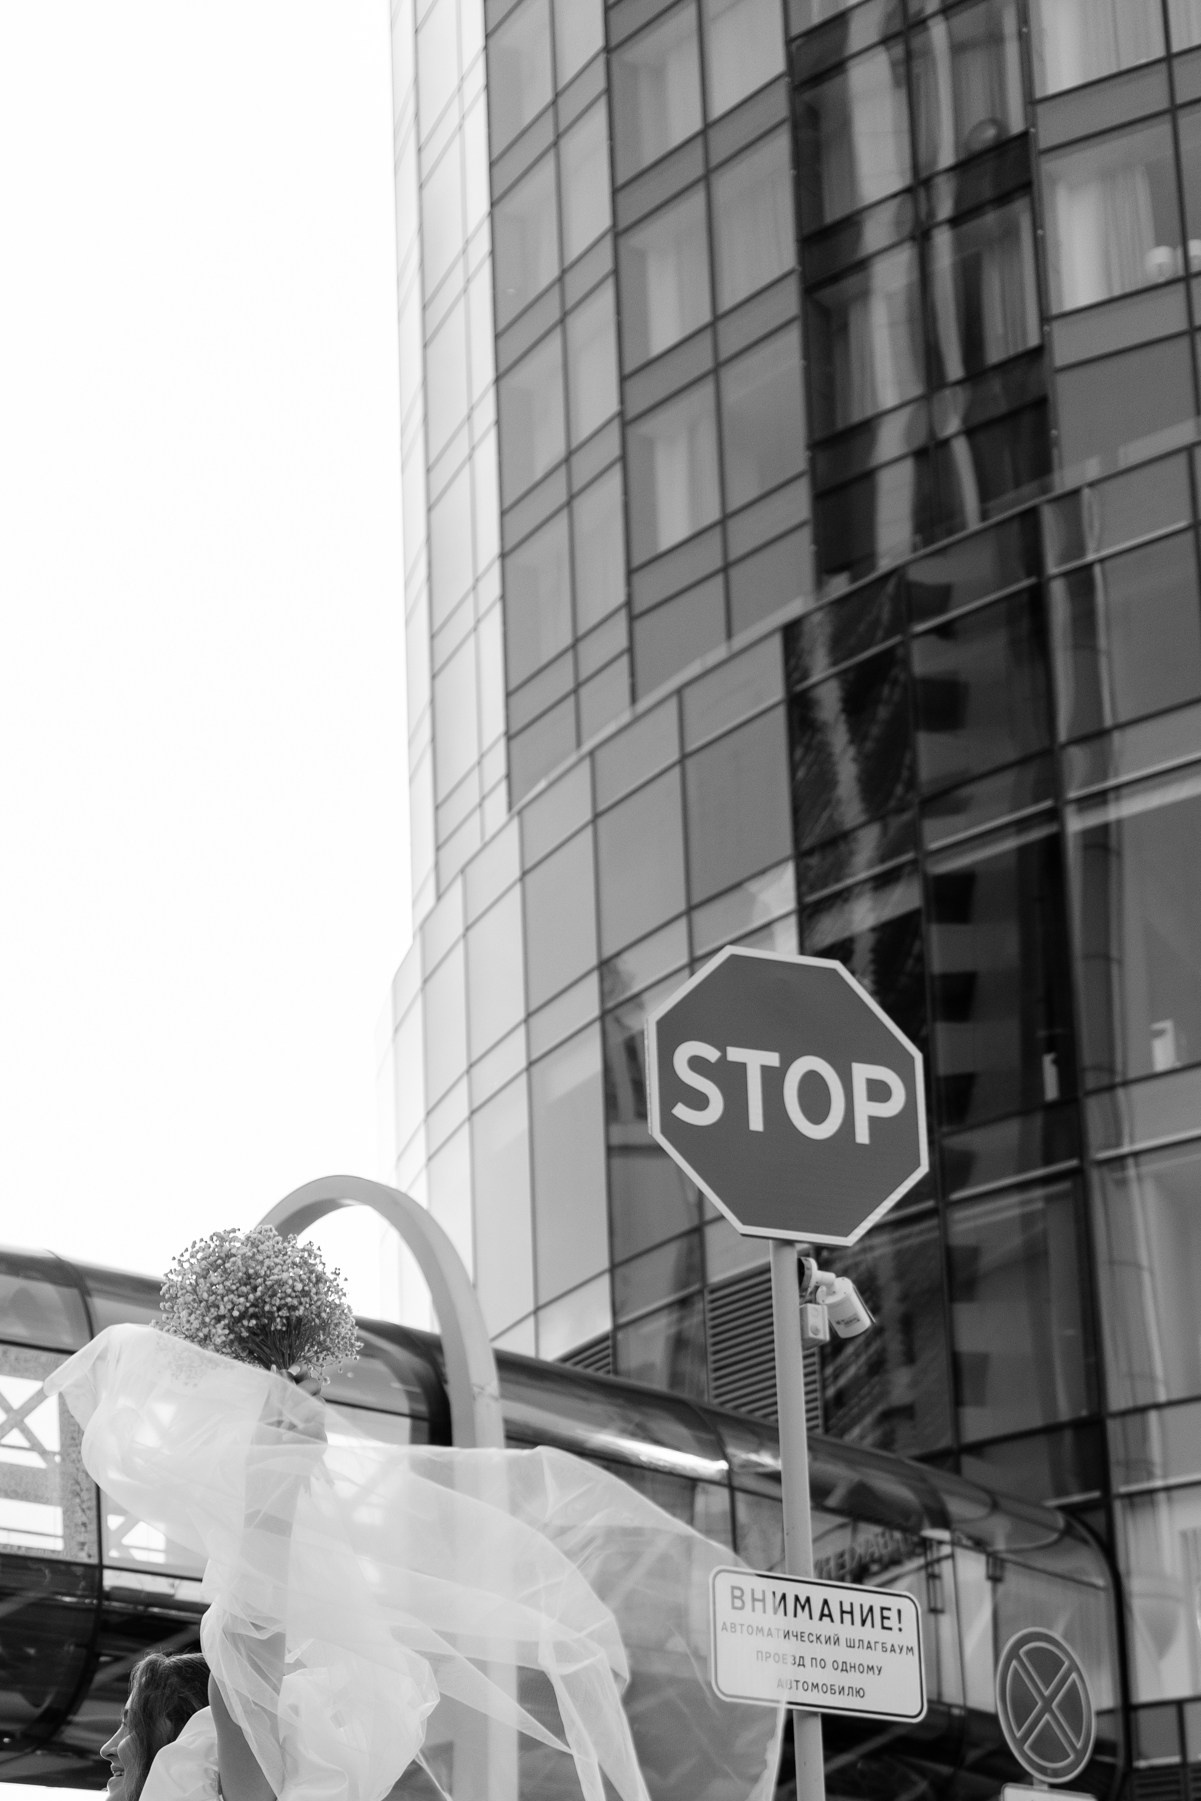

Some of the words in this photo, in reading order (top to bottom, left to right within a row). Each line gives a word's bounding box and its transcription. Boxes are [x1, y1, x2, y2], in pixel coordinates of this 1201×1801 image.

[671, 1040, 906, 1145] STOP
[730, 1585, 903, 1632] ВНИМАНИЕ!
[721, 1621, 840, 1646] АВТОМАТИЧЕСКИЙ
[845, 1638, 914, 1656] ШЛАГБАУМ
[756, 1650, 805, 1668] ПРОЕЗД
[810, 1657, 826, 1669] ПО
[832, 1659, 883, 1676] ОДНОМУ
[777, 1678, 865, 1699] АВТОМОБИЛЮ
